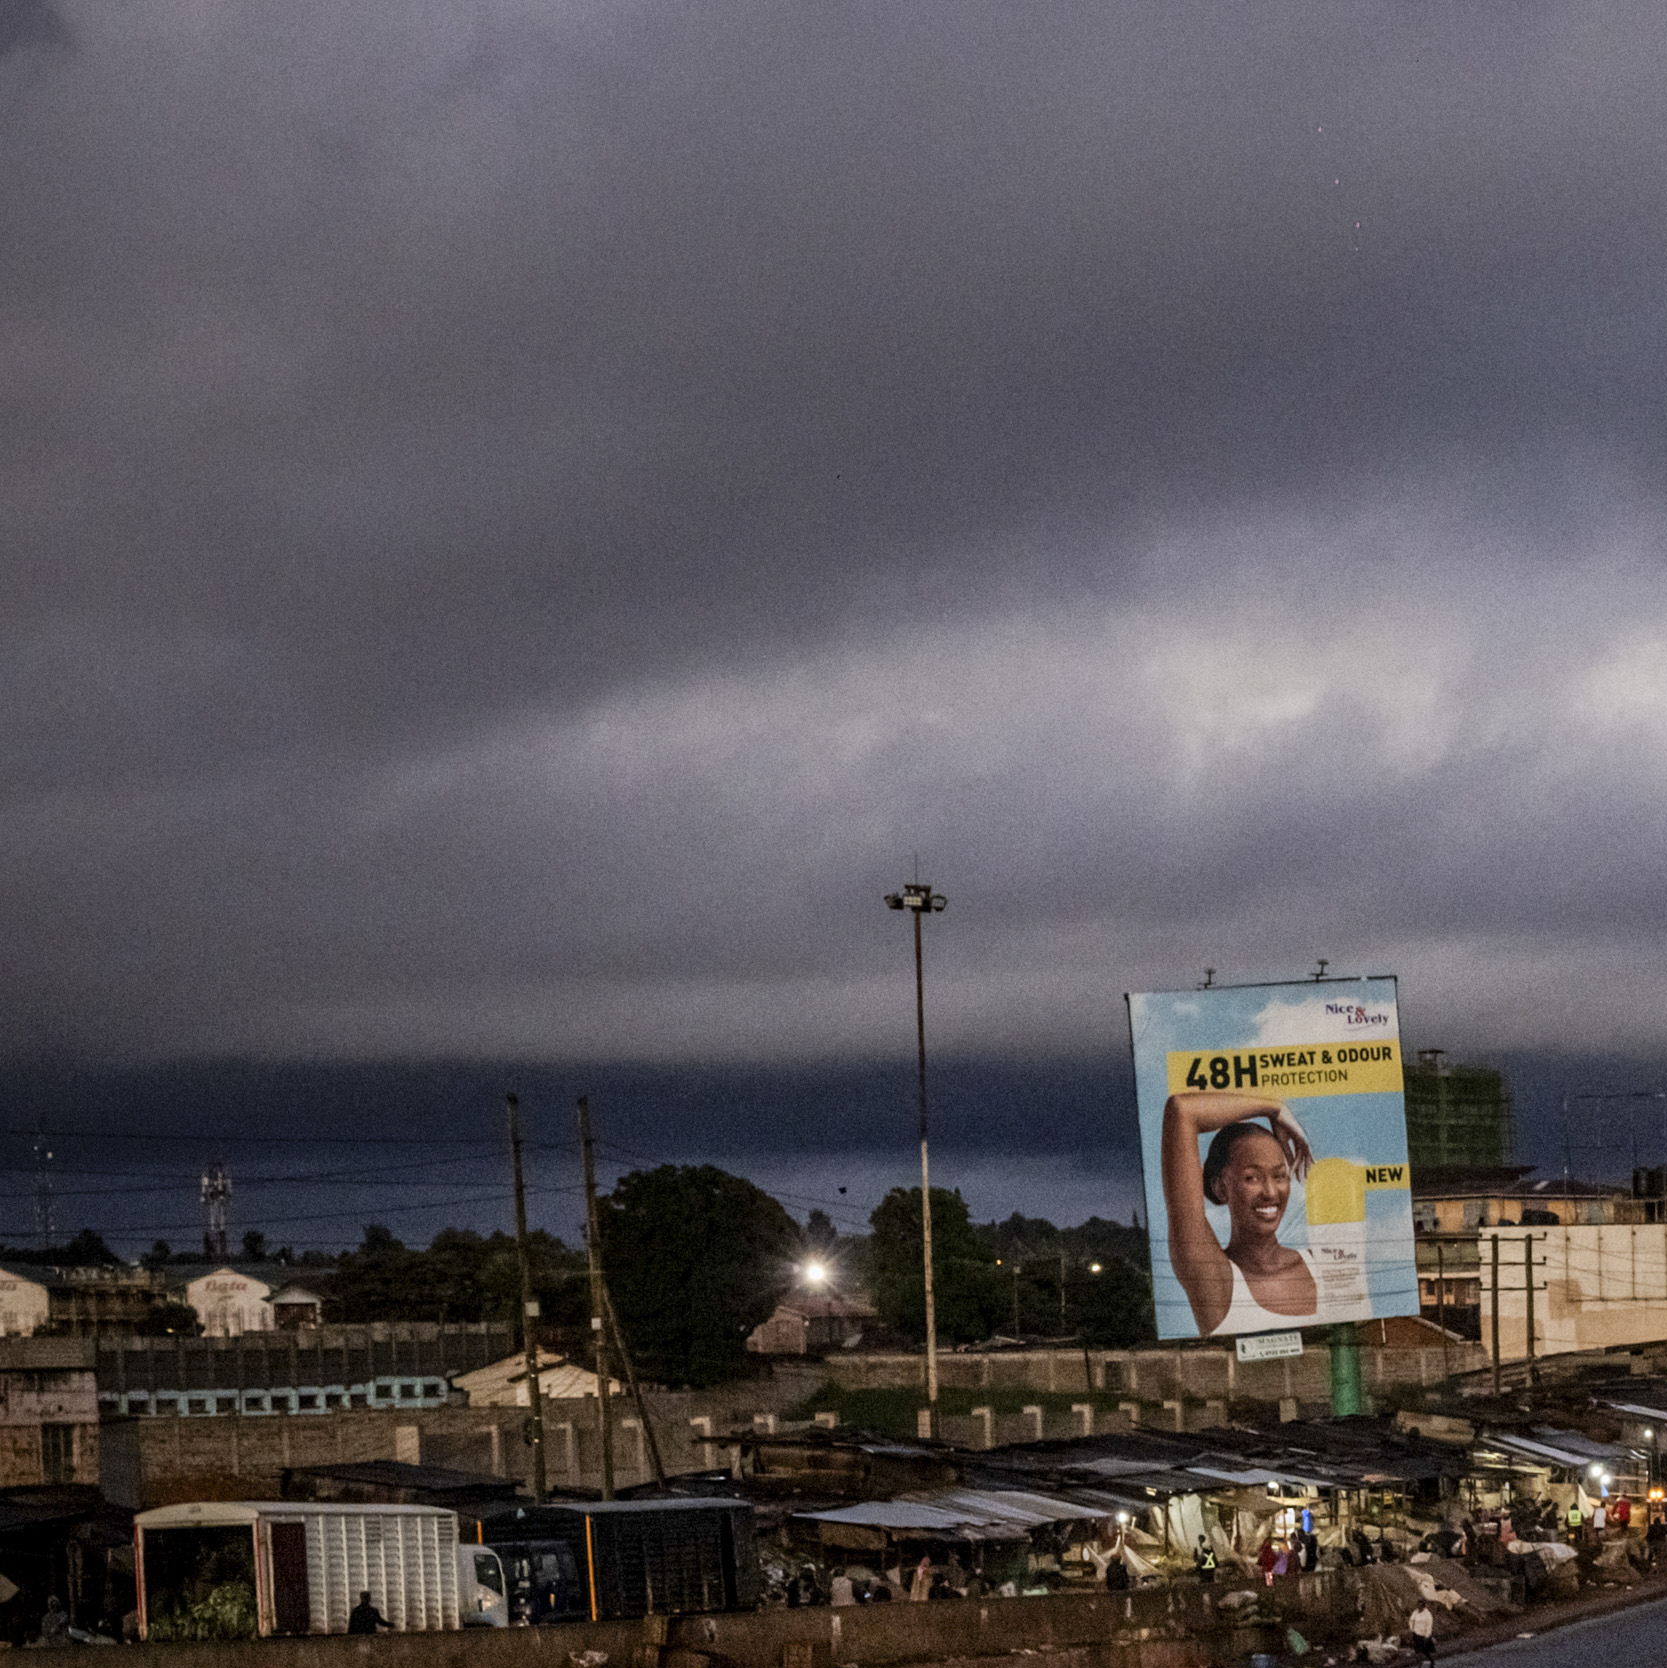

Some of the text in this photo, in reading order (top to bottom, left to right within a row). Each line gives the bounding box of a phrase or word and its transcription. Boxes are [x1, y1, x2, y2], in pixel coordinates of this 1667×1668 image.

[1325, 1003, 1365, 1017] Nice &
[1347, 1013, 1389, 1026] Lovely
[1259, 1046, 1392, 1069] SWEAT & ODOUR
[1186, 1055, 1258, 1090] 48H
[1261, 1068, 1348, 1087] PROTECTION
[1366, 1167, 1403, 1184] NEW
[204, 1279, 248, 1293] Bata
